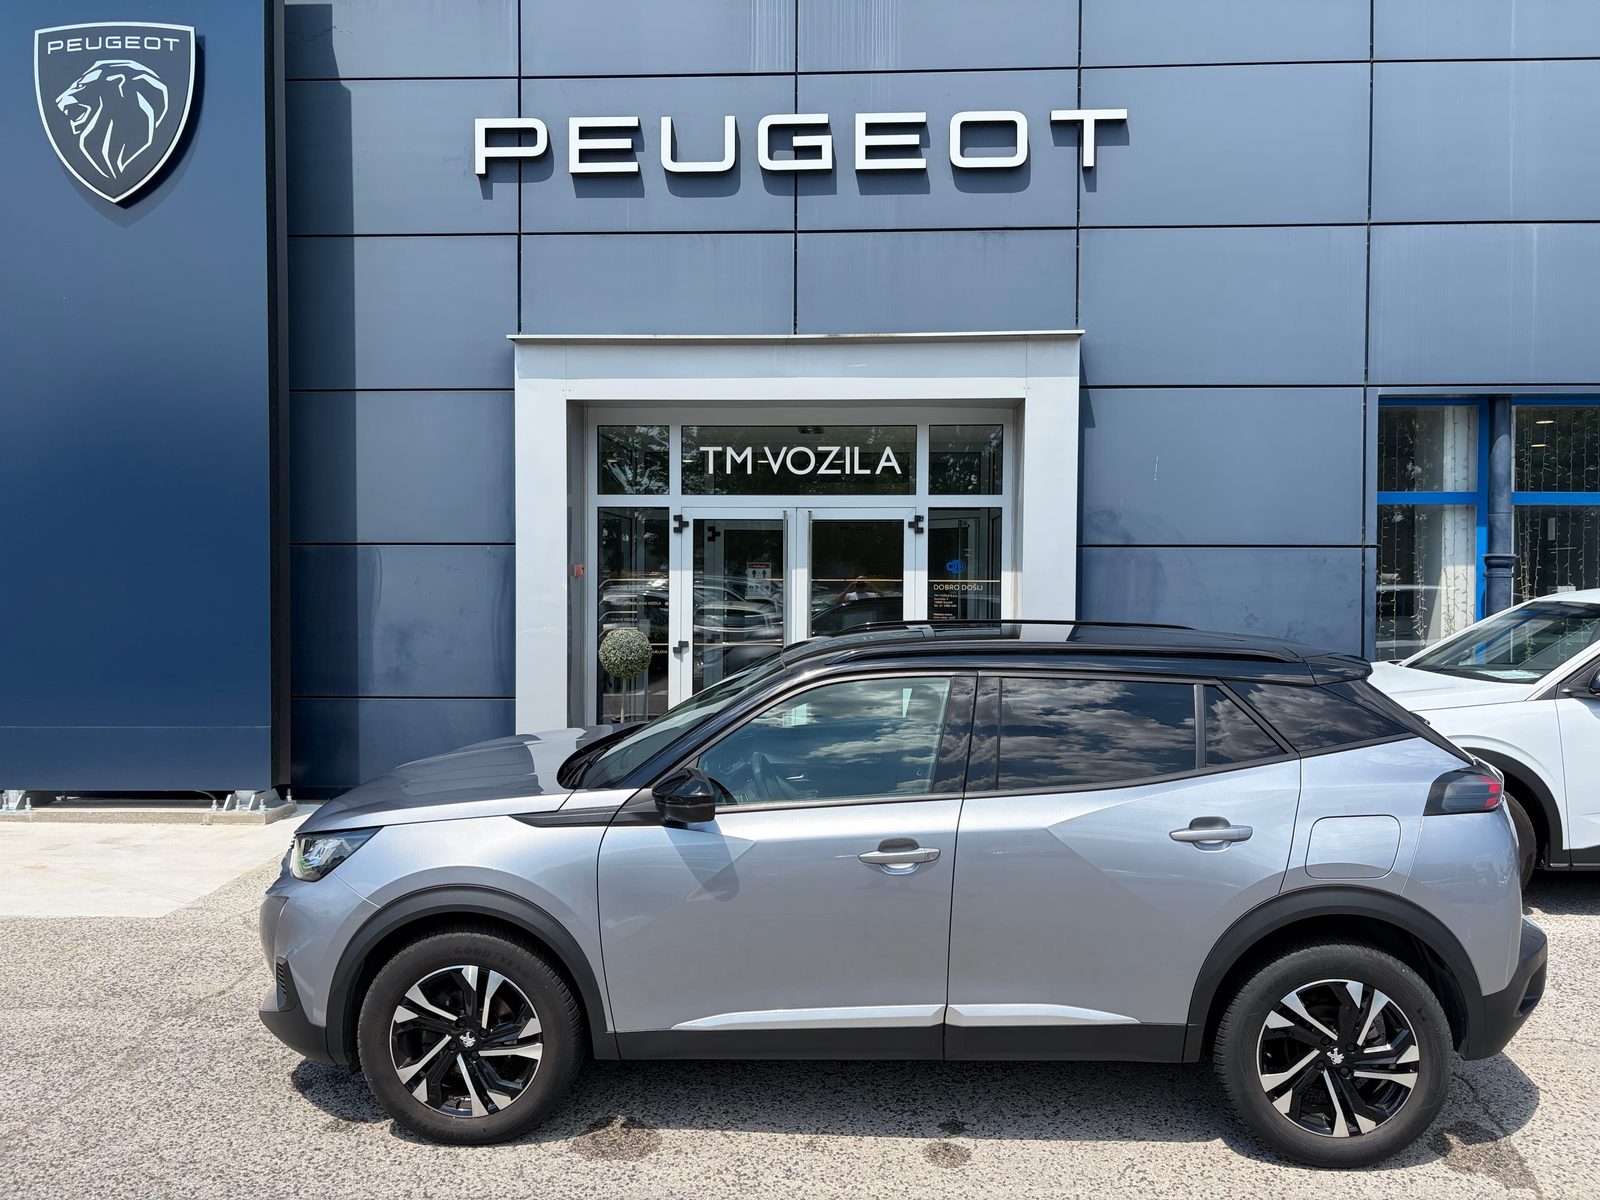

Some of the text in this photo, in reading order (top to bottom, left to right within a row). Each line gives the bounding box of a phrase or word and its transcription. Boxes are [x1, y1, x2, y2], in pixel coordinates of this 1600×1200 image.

[47, 35, 180, 55] PEUGEOT
[474, 108, 1128, 175] PEUGEOT
[699, 446, 902, 475] TM VOZILA
[961, 583, 983, 591] DOŠLI
